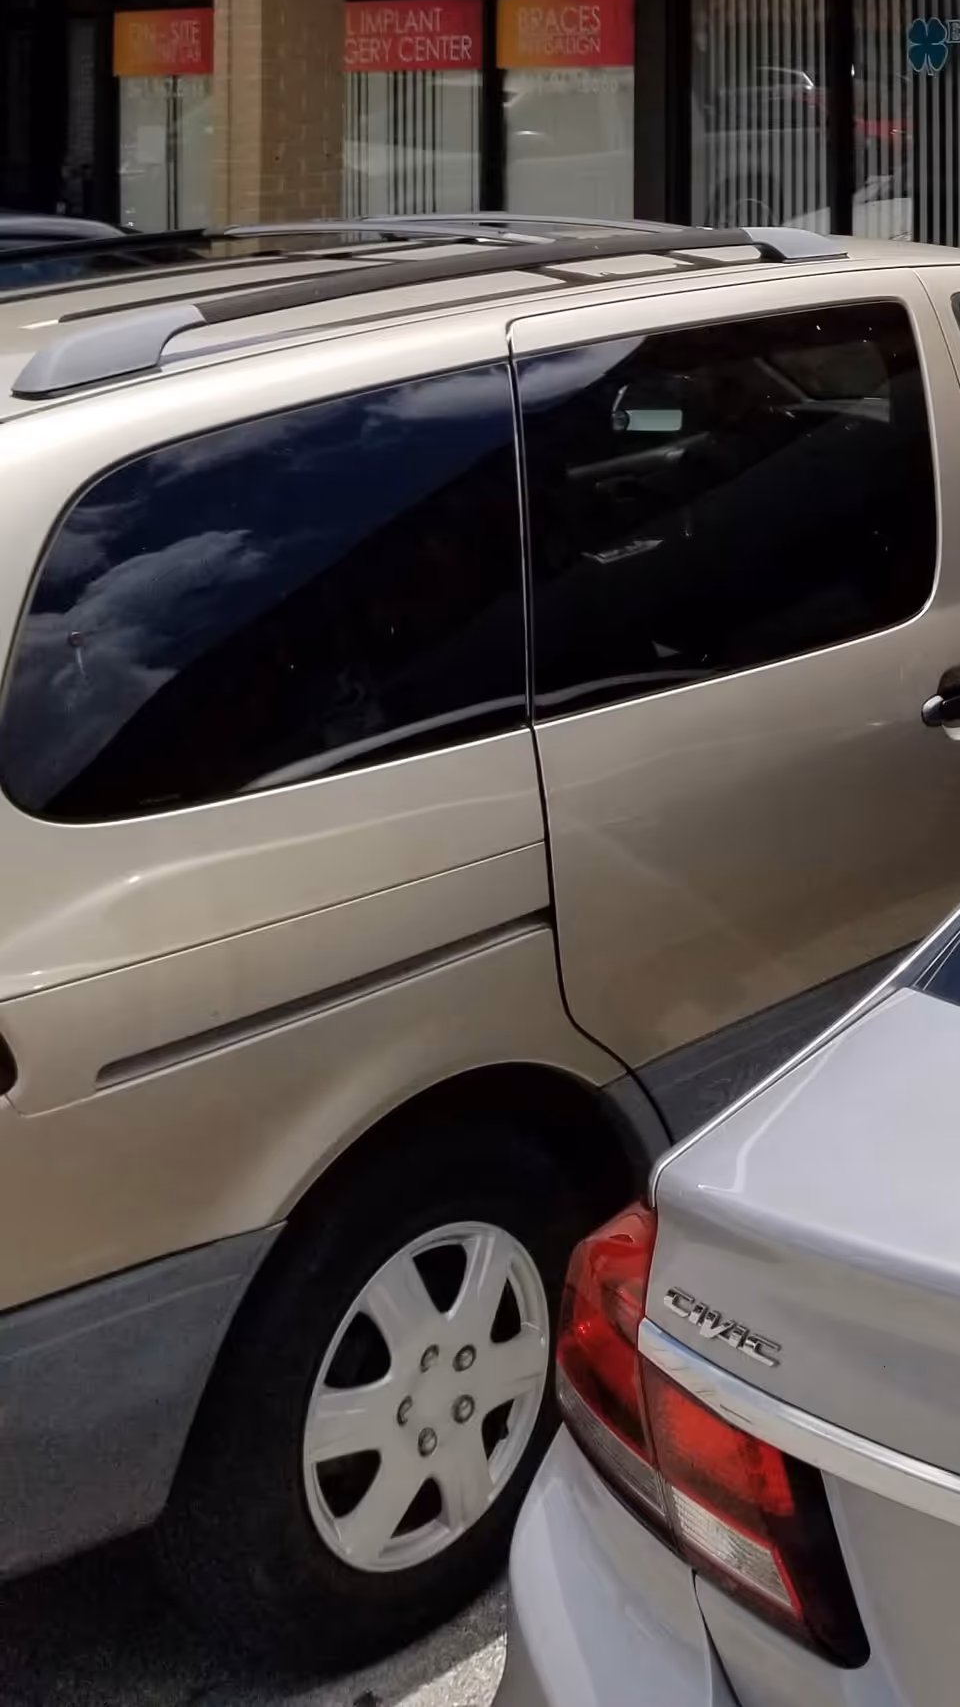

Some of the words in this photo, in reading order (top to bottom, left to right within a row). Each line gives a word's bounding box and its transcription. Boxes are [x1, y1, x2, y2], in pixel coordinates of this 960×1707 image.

[360, 7, 444, 34] IMPLANT
[517, 5, 601, 35] BRACES
[399, 35, 473, 63] CENTER
[663, 1286, 782, 1368] CIVIC
